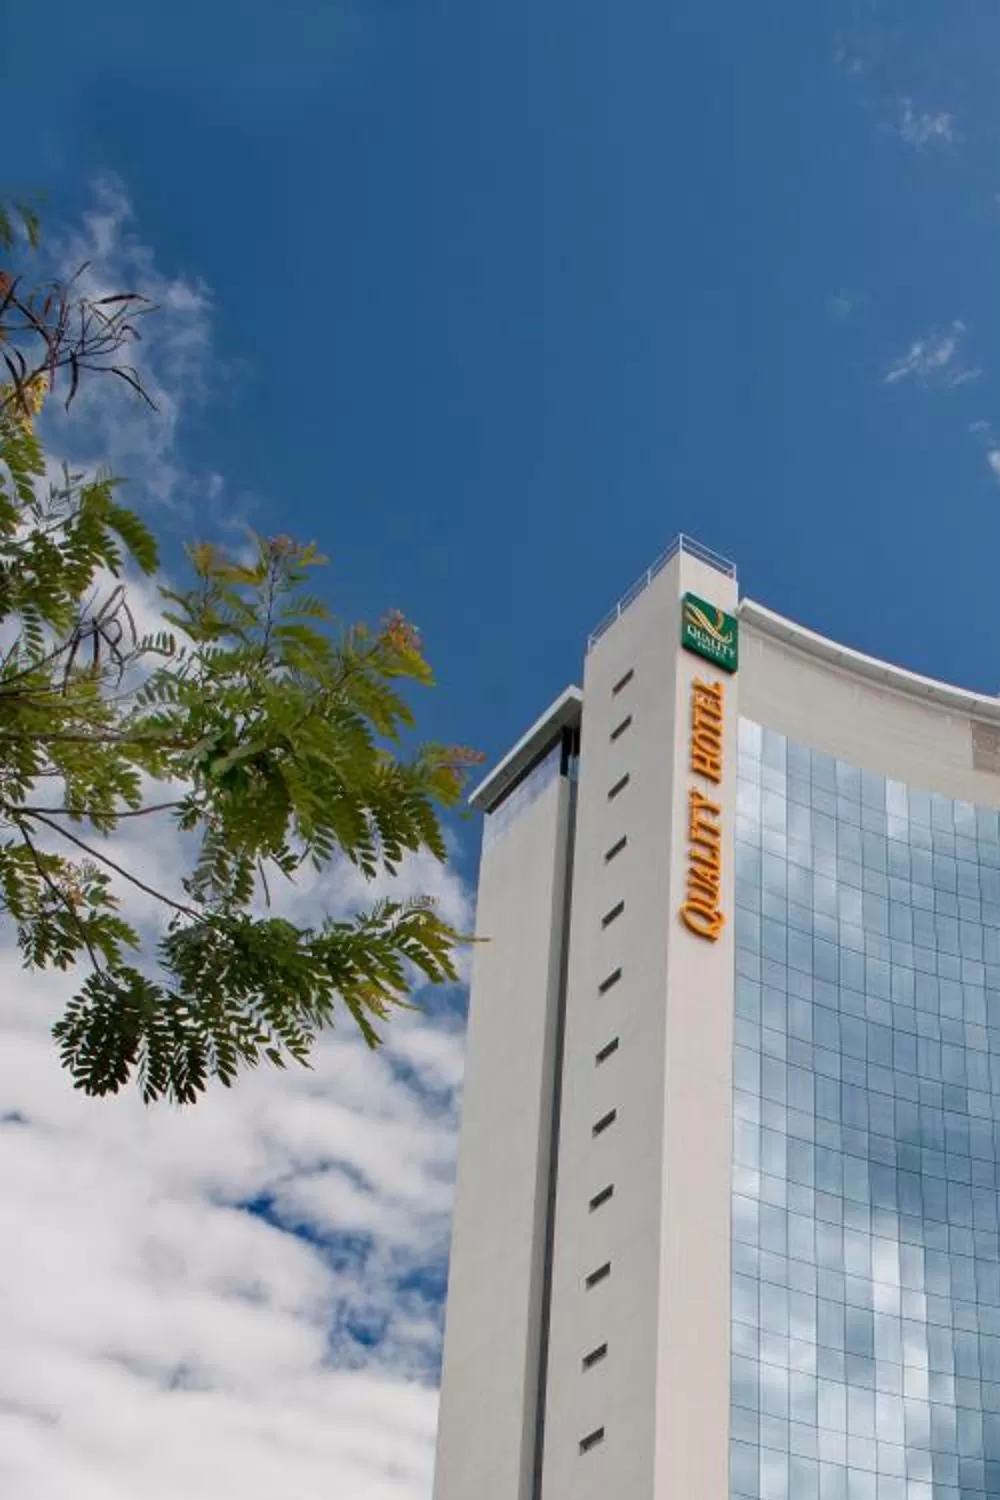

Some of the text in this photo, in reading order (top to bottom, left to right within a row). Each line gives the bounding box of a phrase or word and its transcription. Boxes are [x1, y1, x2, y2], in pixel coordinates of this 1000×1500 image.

[687, 624, 736, 658] QUALITY
[692, 675, 723, 784] HOTEL
[682, 789, 726, 941] QUALITY
